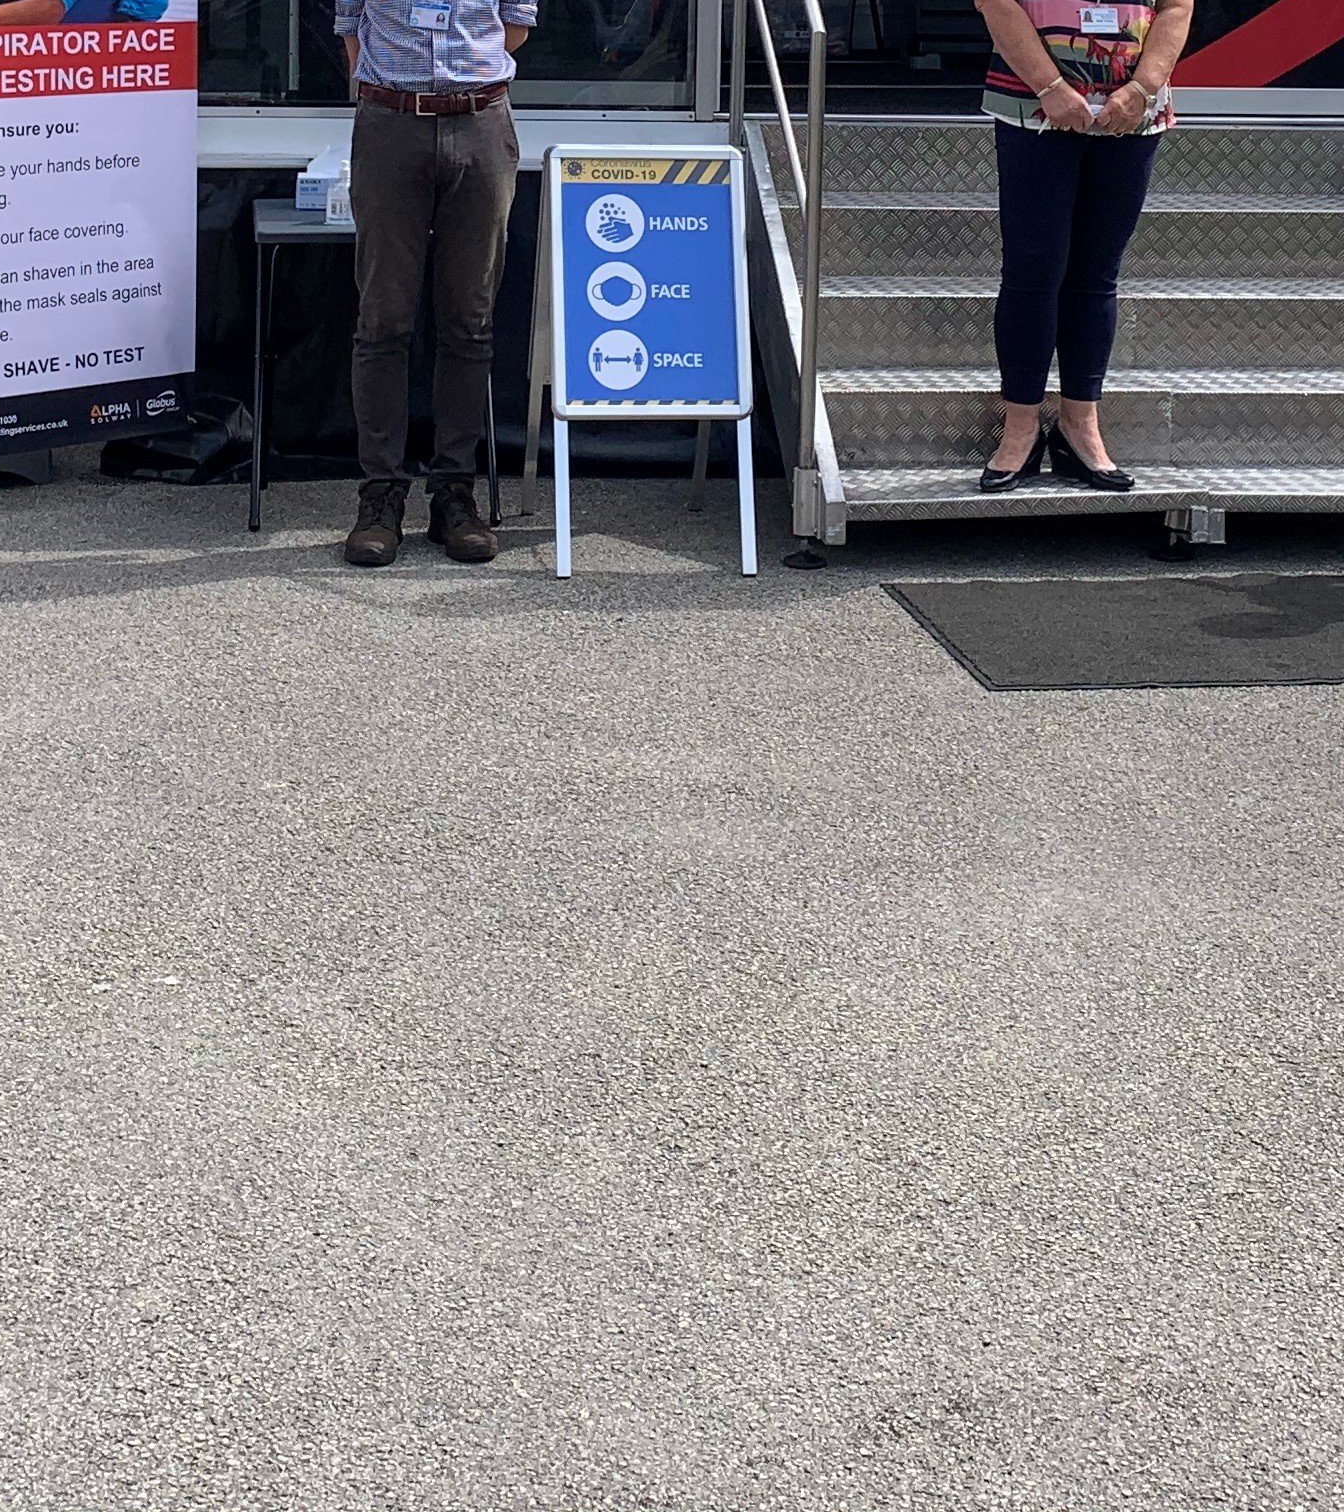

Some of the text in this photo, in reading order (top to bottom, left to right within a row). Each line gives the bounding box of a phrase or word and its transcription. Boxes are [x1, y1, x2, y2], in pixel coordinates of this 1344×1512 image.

[108, 28, 175, 53] FACE
[102, 63, 170, 89] HERE
[45, 122, 79, 139] you:
[9, 162, 43, 181] your
[47, 156, 91, 174] hands
[95, 153, 141, 170] before
[591, 168, 657, 180] COVID-19
[28, 227, 60, 242] face
[63, 222, 129, 240] covering.
[649, 216, 709, 231] HANDS
[23, 265, 75, 282] shaven
[80, 264, 92, 276] in
[96, 259, 120, 275] the
[123, 257, 154, 272] area
[26, 292, 66, 310] mask
[70, 287, 108, 306] seals
[111, 281, 163, 304] against
[651, 284, 690, 299] FACE
[3, 356, 61, 378] SHAVE
[75, 352, 99, 370] NO
[102, 346, 145, 365] TEST
[653, 352, 703, 368] SPACE
[90, 402, 132, 418] ALPHA
